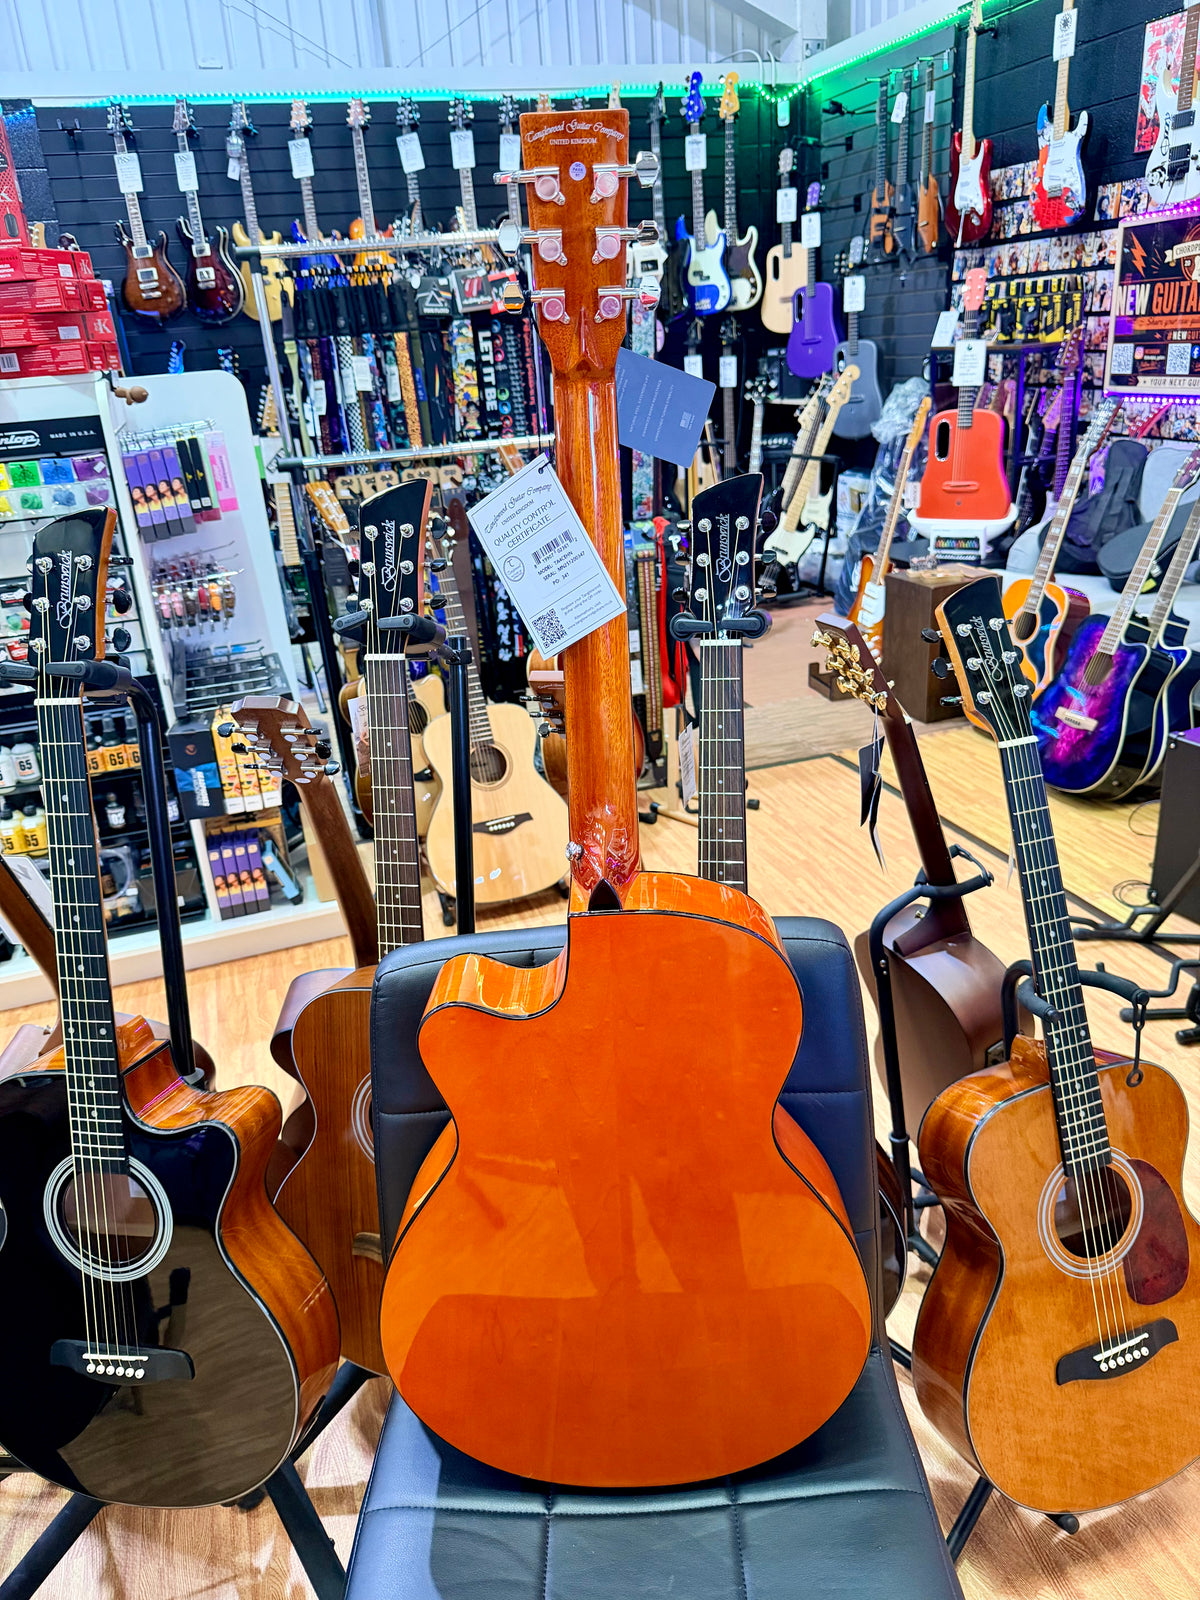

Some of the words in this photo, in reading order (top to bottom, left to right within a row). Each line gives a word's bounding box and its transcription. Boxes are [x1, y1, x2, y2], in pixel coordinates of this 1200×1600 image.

[525, 120, 564, 142] Tanglewood
[566, 119, 592, 134] Guitar
[593, 122, 624, 142] Company
[1116, 283, 1150, 316] NEW
[1152, 280, 1200, 314] GUITA
[478, 330, 494, 364] LET
[482, 366, 496, 386] IT
[484, 387, 498, 412] BE
[485, 502, 507, 534] Tanglewood
[508, 492, 526, 510] Guitar
[526, 484, 552, 497] Company
[494, 520, 522, 546] QUALITY
[523, 500, 556, 526] CONTROL
[501, 510, 516, 526] UNITED
[515, 499, 534, 518] KINGDOM
[507, 514, 551, 548] CERTIFICATE
[715, 513, 732, 582] Brunswick
[381, 519, 397, 592] Brunswick
[538, 565, 553, 575] MODEL:
[56, 550, 73, 629] Brunswick
[969, 616, 1003, 681] Brunswick
[18, 755, 32, 771] 65
[109, 751, 125, 766] 65
[24, 834, 39, 848] 65
